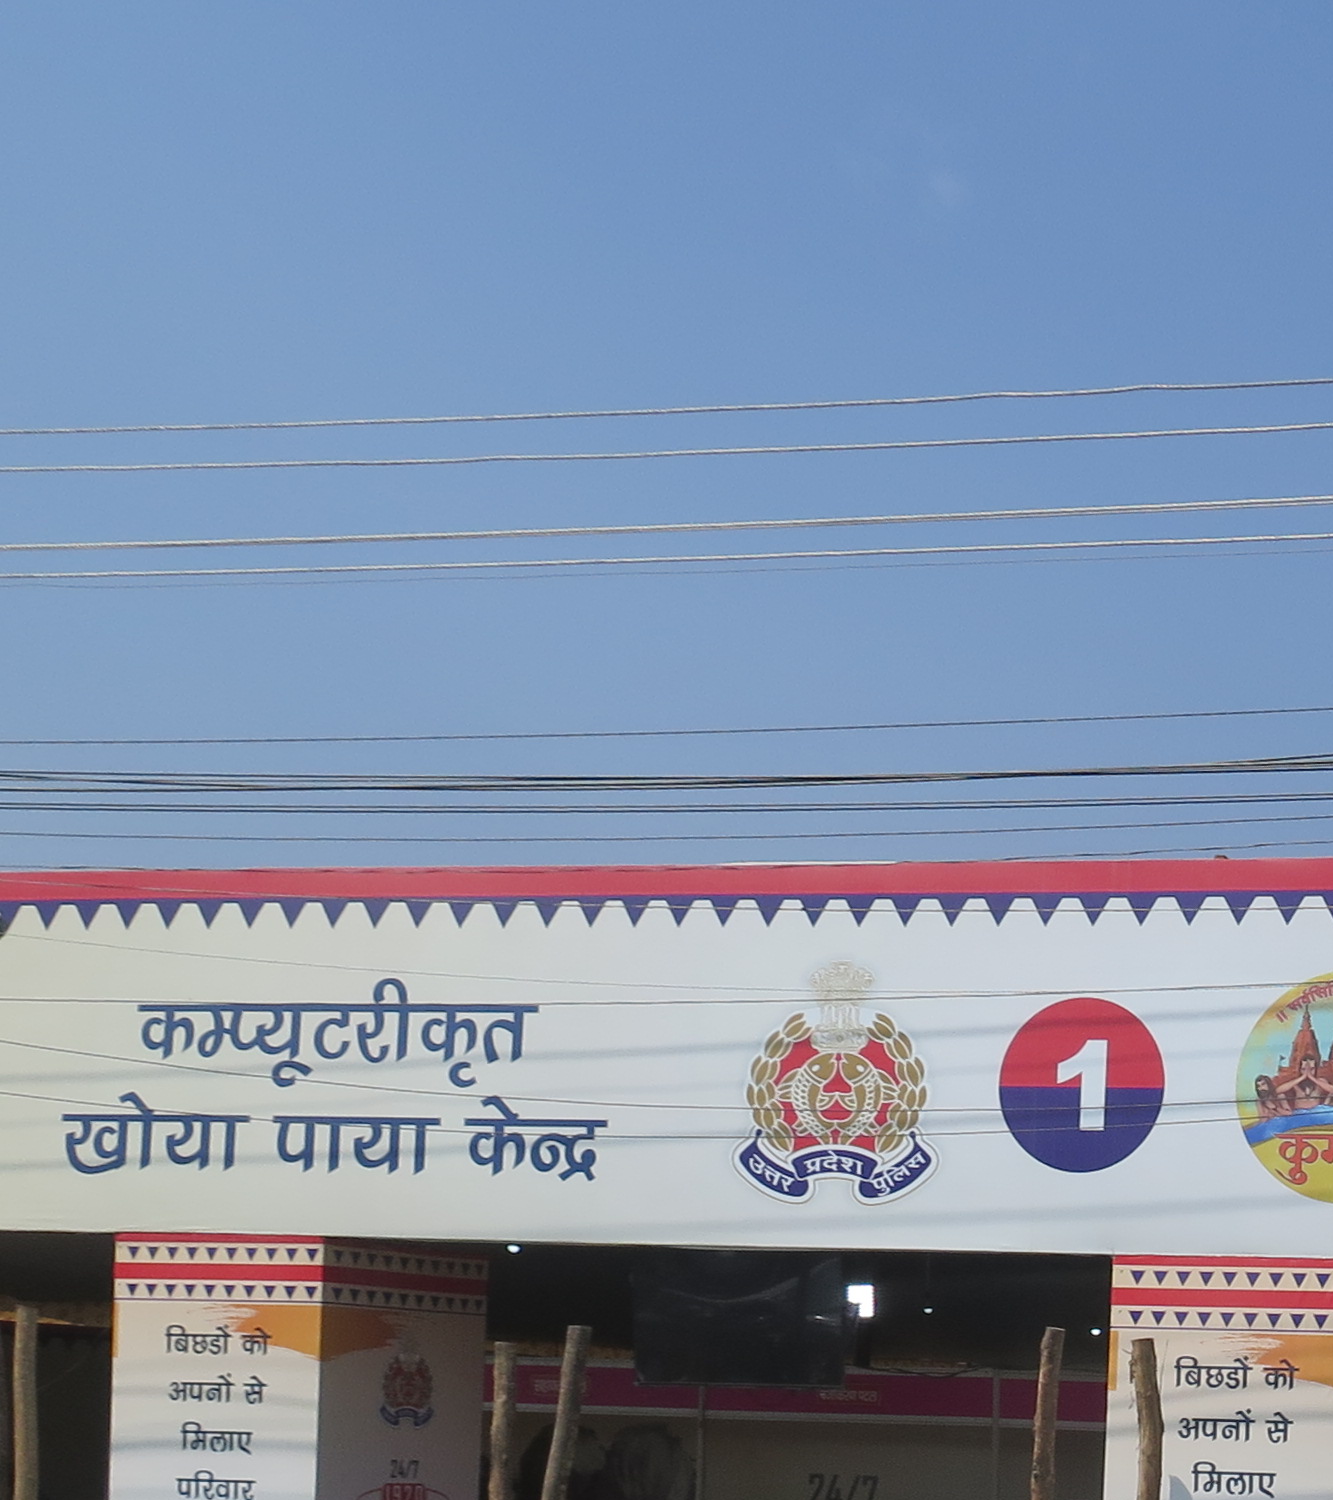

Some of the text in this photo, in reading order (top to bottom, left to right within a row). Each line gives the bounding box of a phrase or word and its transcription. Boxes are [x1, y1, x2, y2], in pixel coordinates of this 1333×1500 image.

[138, 978, 539, 1087] कम्प्यूटरीकृत
[1057, 1039, 1109, 1132] 1
[62, 1092, 608, 1182] खोया पाया केन्द्र
[749, 1151, 926, 1196] उत्तर प्रदेश पुलिस
[241, 1327, 272, 1356] को
[168, 1374, 267, 1405] अपनों से
[1264, 1359, 1299, 1391] को
[181, 1422, 253, 1456] मिलाए
[1177, 1408, 1293, 1444] अपनों से
[390, 1459, 419, 1479] 24/7
[1192, 1461, 1277, 1499] मिलाए
